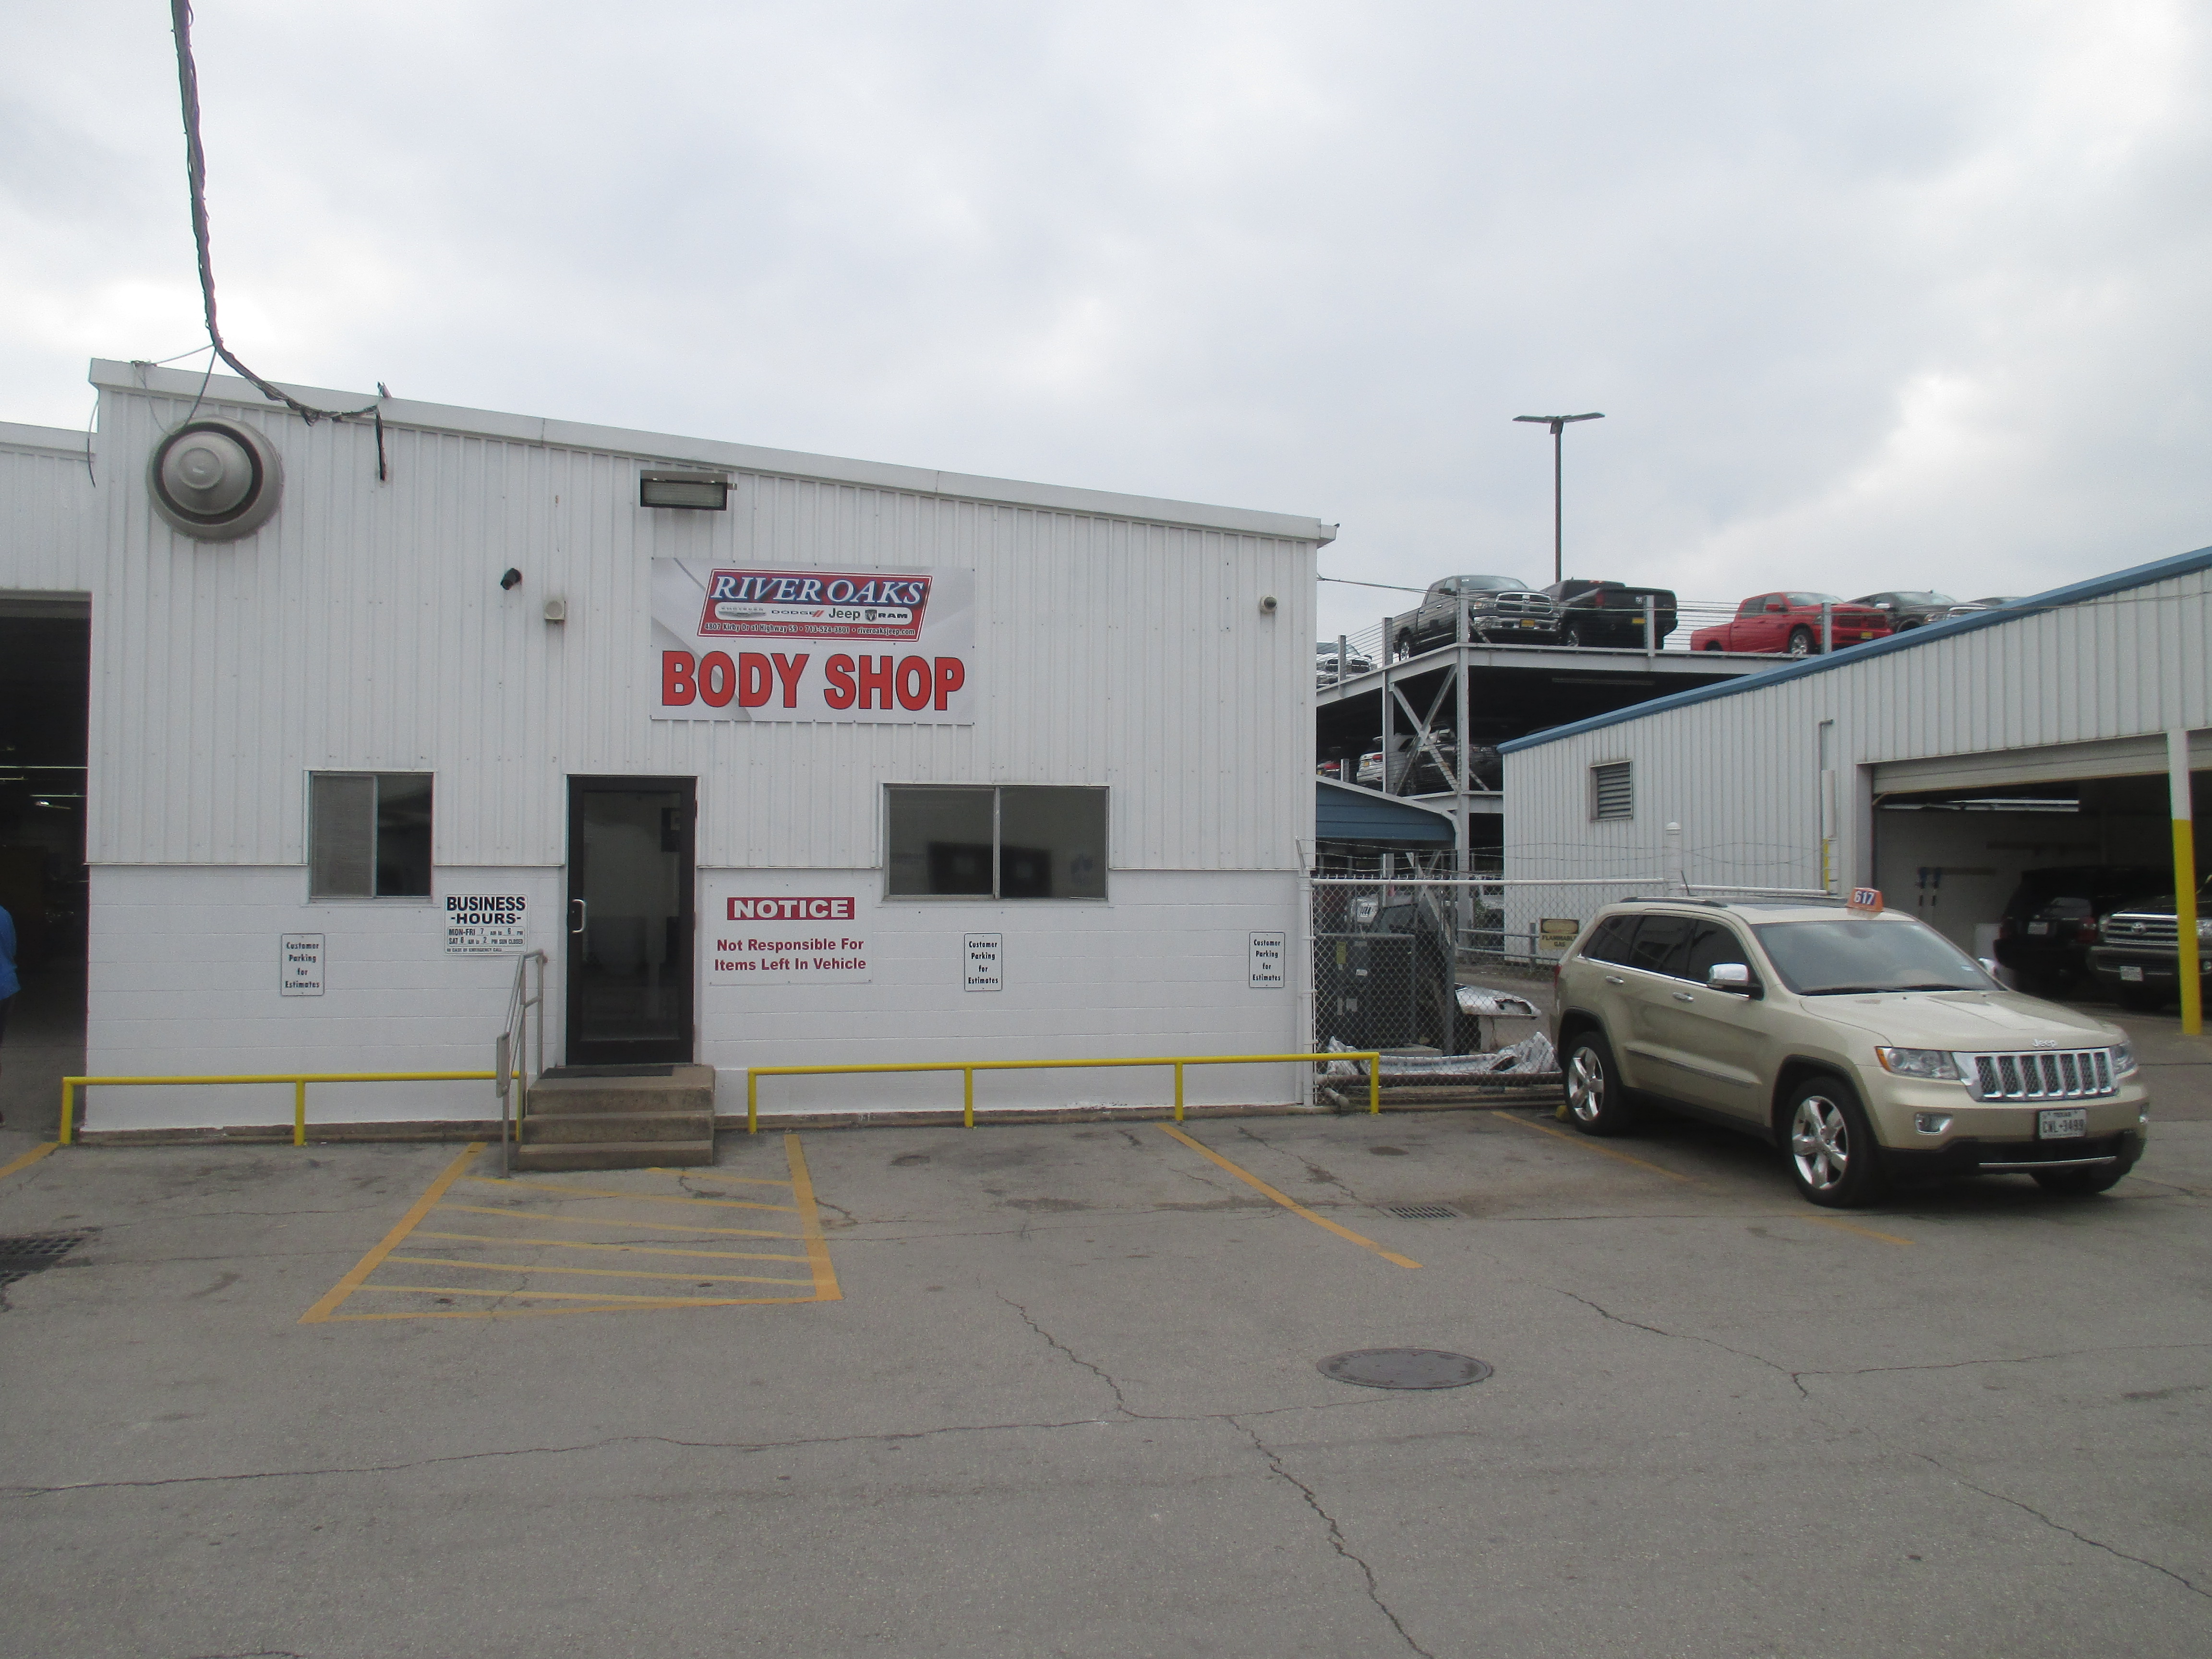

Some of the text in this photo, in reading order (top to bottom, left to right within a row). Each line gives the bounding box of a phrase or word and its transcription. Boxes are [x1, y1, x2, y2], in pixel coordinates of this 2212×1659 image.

[710, 576, 924, 604] RIVER OAKS
[829, 608, 861, 621] Jeep
[723, 623, 740, 632] Kirby
[760, 624, 787, 633] Highway
[805, 625, 850, 634] 713-524-3801
[857, 627, 915, 636] riveroaksjeep.com
[661, 650, 965, 711] BODY SHOP
[447, 896, 526, 911] BUSINESS
[1854, 890, 1875, 905] 617
[733, 899, 849, 919] NOTICE
[717, 938, 864, 953] Not Responsible For
[289, 953, 317, 963] Parking
[971, 952, 995, 960] Parking
[1256, 950, 1278, 958] Parking
[714, 957, 866, 971] Items Left In Vehicle
[297, 967, 308, 975] for
[285, 980, 320, 988] Estimates
[2031, 1038, 2056, 1048] Jeep
